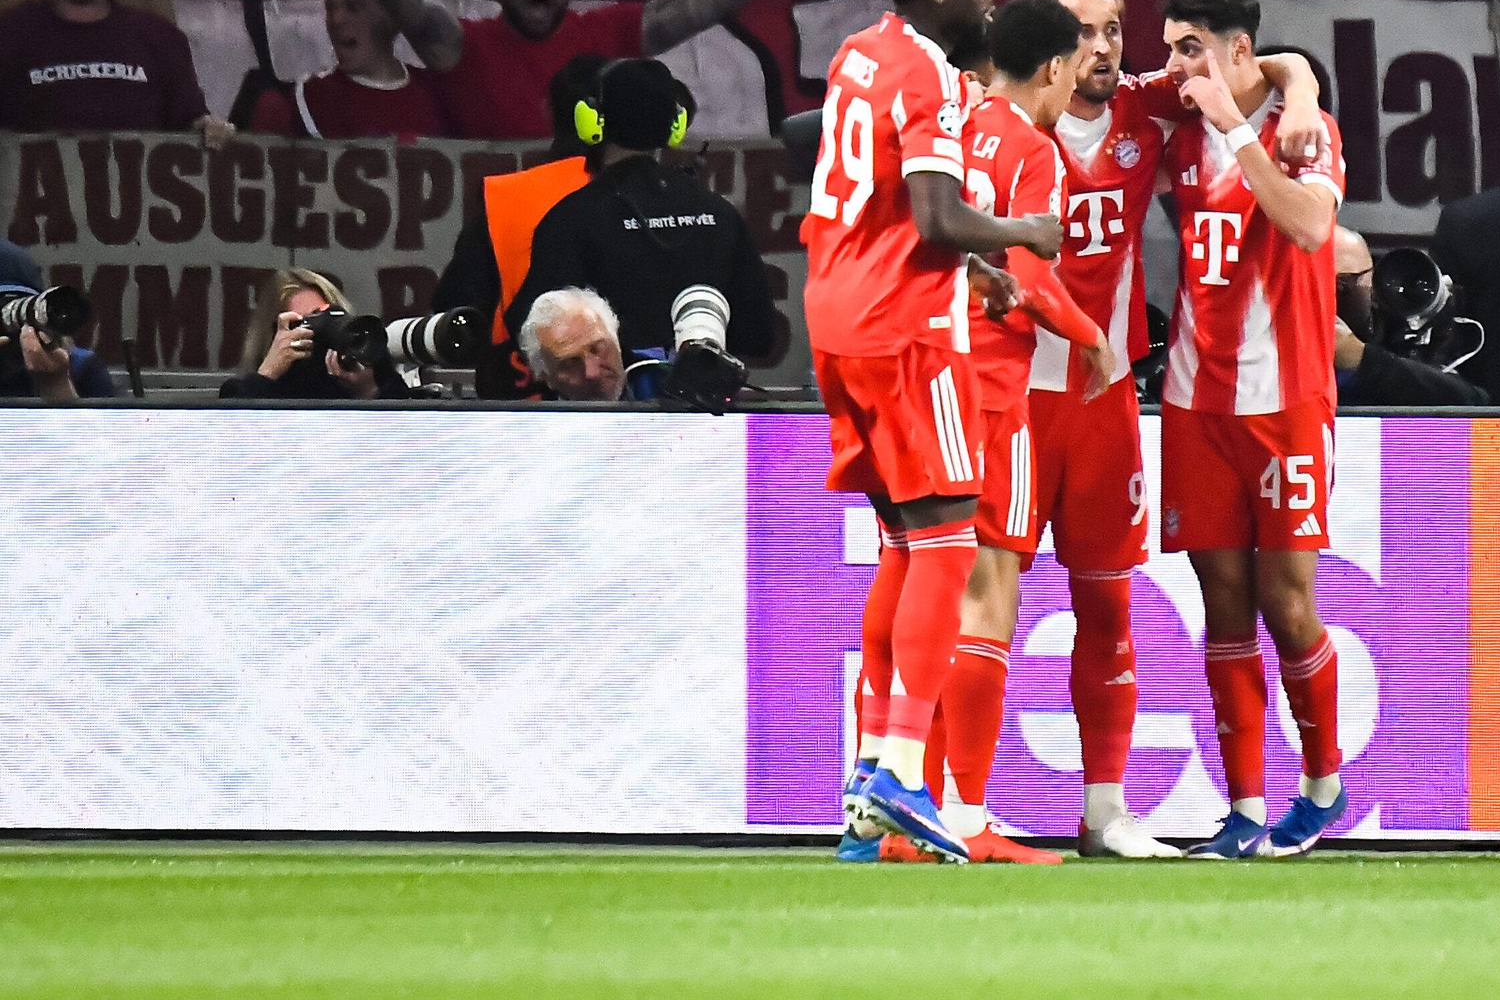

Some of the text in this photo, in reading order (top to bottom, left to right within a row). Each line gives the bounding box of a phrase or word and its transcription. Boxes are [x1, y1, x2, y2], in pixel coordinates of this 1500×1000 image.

[810, 84, 875, 228] 19
[1128, 471, 1148, 527] 9
[1260, 455, 1315, 510] 45
